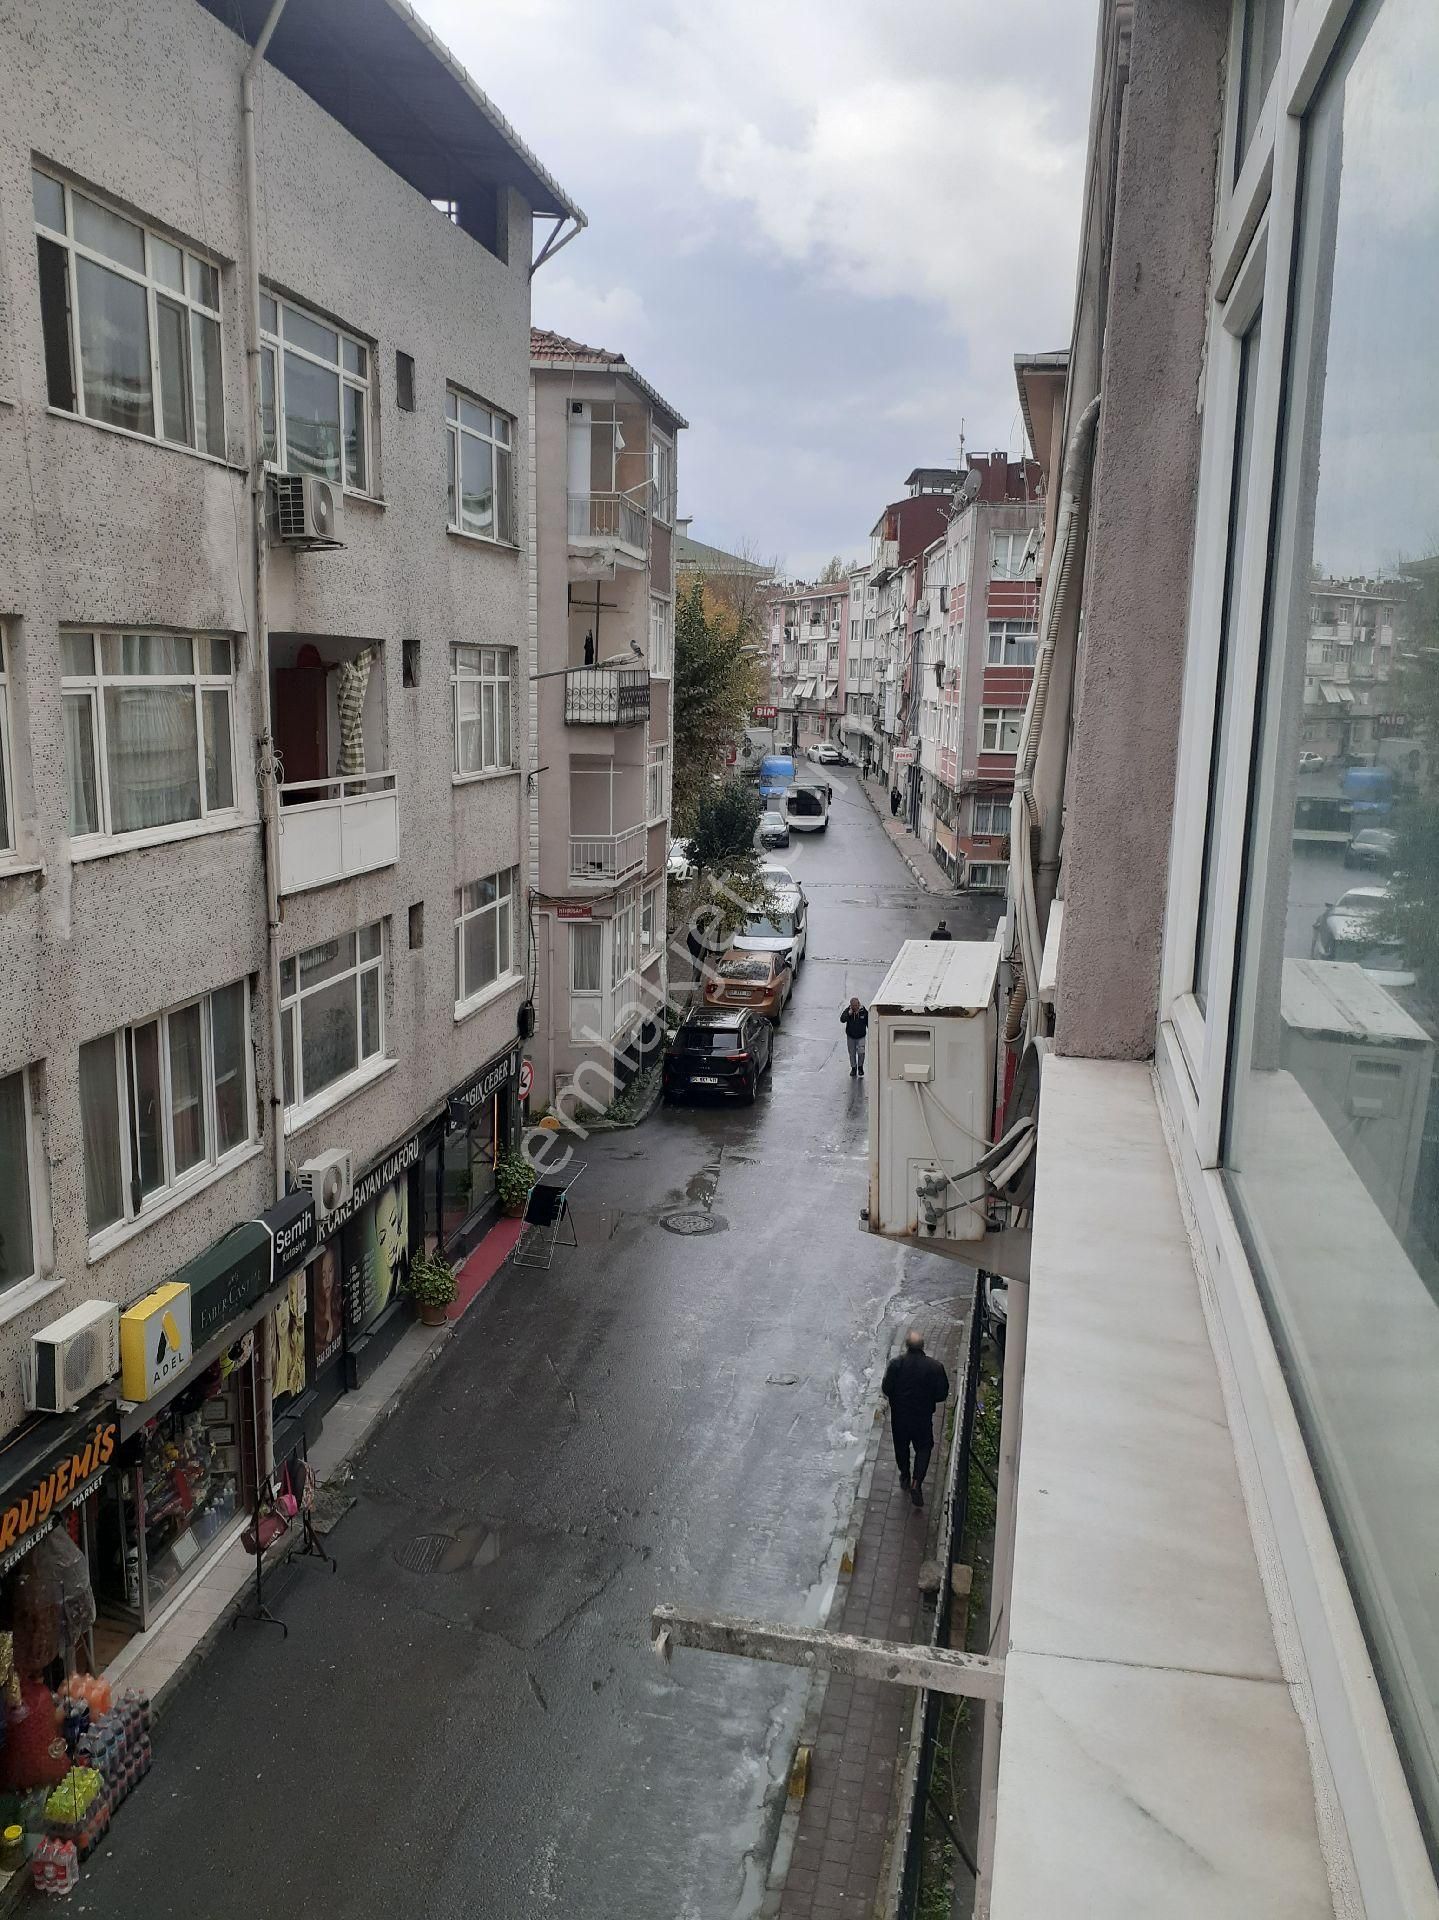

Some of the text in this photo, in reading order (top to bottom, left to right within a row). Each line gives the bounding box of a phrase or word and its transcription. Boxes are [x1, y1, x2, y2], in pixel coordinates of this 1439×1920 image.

[353, 1171, 381, 1212] BAYAN
[276, 1210, 312, 1254] Semih
[153, 1352, 185, 1385] ADEL
[72, 1475, 104, 1511] MARKET
